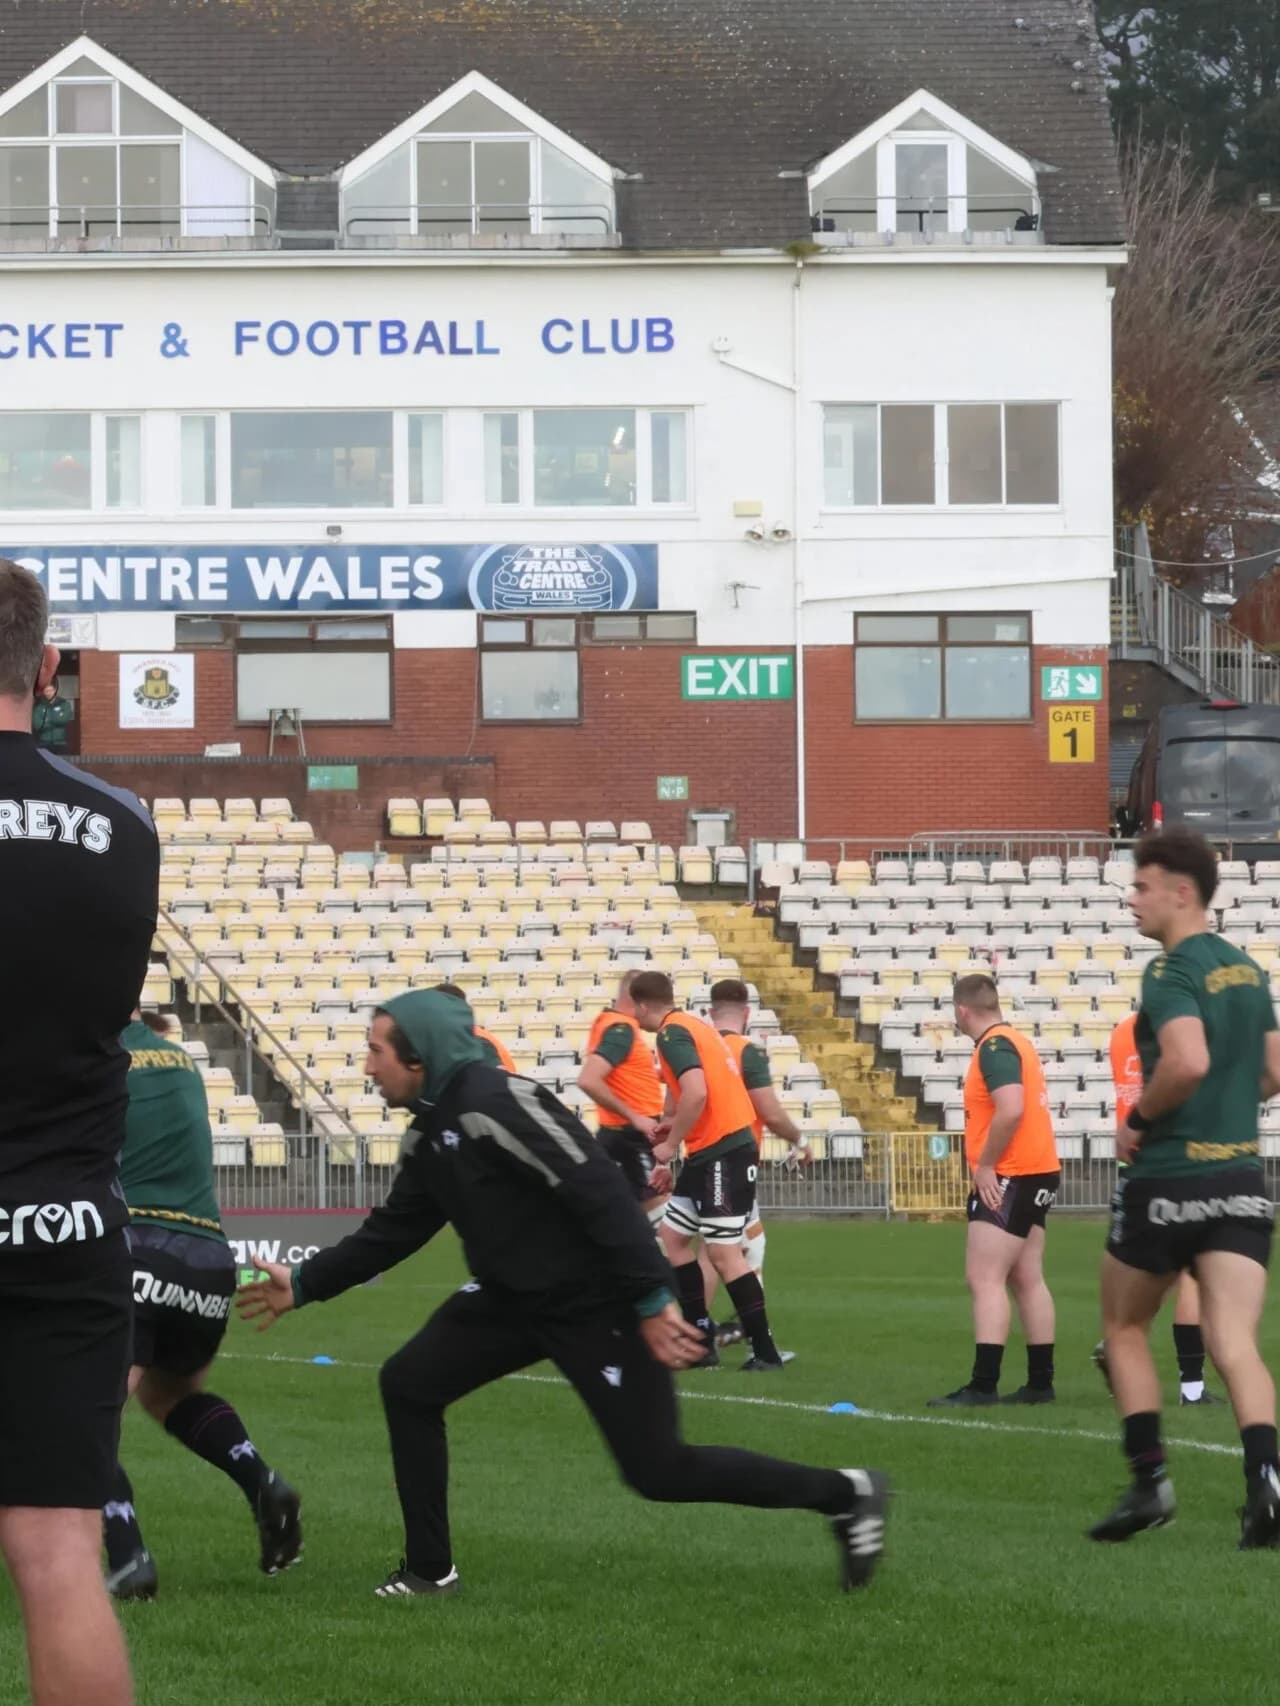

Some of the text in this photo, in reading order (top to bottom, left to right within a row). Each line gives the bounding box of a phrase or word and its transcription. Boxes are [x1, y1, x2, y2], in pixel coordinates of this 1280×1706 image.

[160, 324, 191, 358] &
[235, 320, 501, 357] FOOTBALL
[542, 318, 676, 354] CLUB
[528, 548, 577, 559] THE
[511, 560, 595, 573] TRADE
[245, 557, 443, 601] WALES
[519, 573, 588, 590] CENTRE
[535, 591, 571, 599] WALES
[687, 656, 789, 696] EXIT
[1052, 711, 1091, 722] GATE
[1063, 727, 1078, 758] 1
